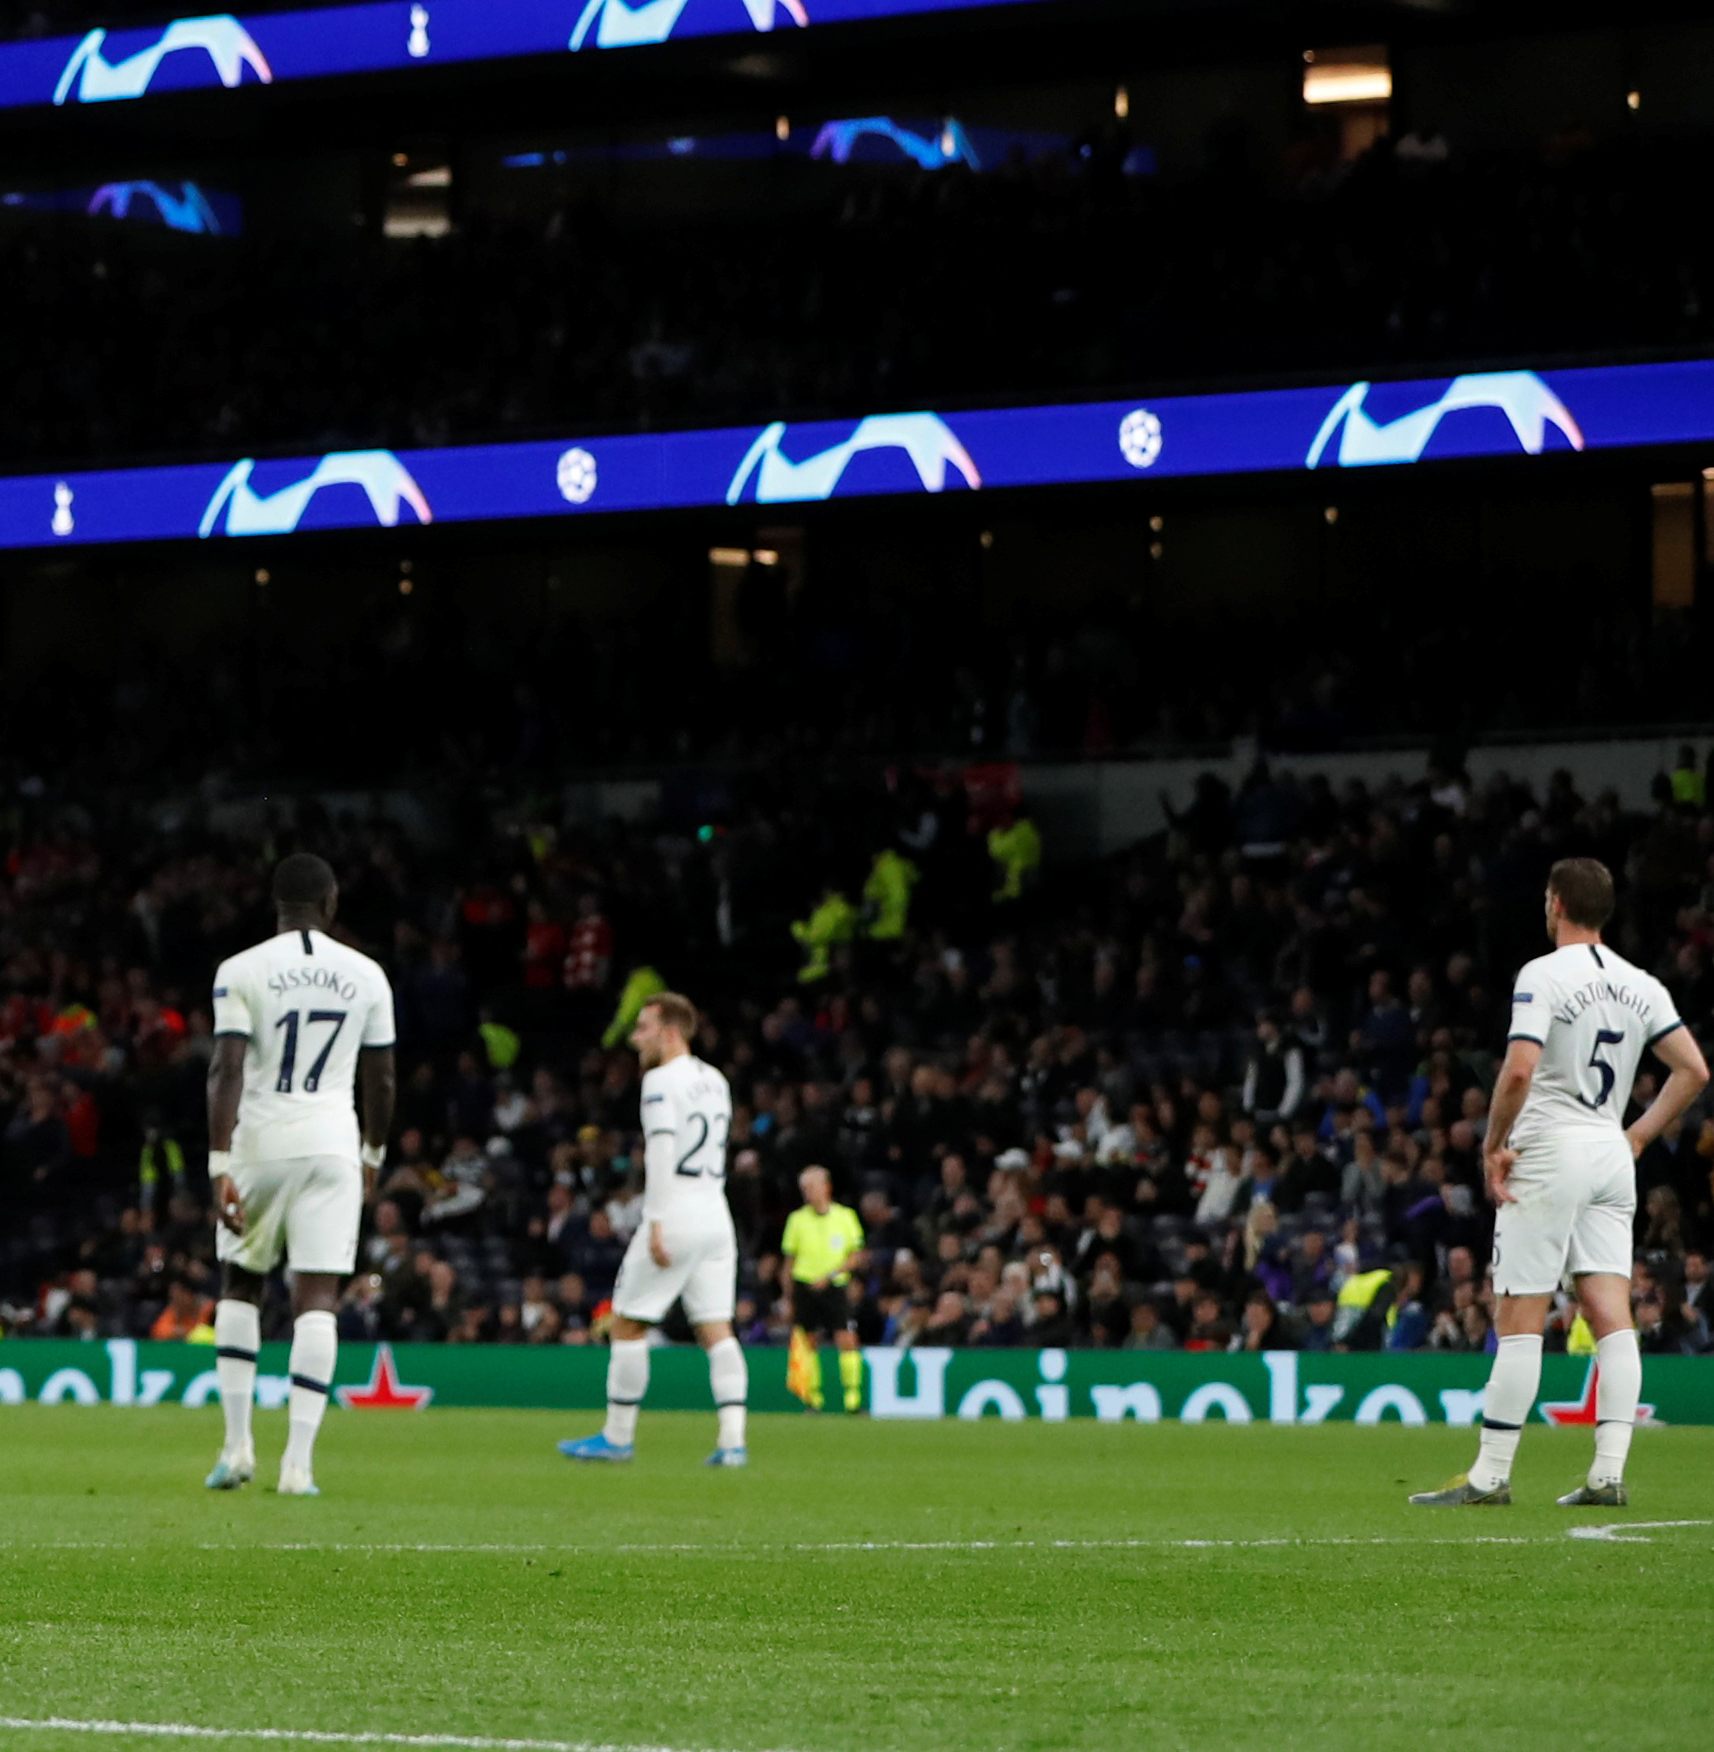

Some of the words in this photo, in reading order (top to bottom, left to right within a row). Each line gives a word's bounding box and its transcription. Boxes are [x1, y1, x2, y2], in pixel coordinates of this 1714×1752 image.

[268, 968, 356, 1001] SISSOKO
[1554, 981, 1652, 1025] VERTONGHE
[275, 1010, 347, 1093] 17
[1578, 1029, 1625, 1110] 5
[676, 1112, 731, 1178] 23
